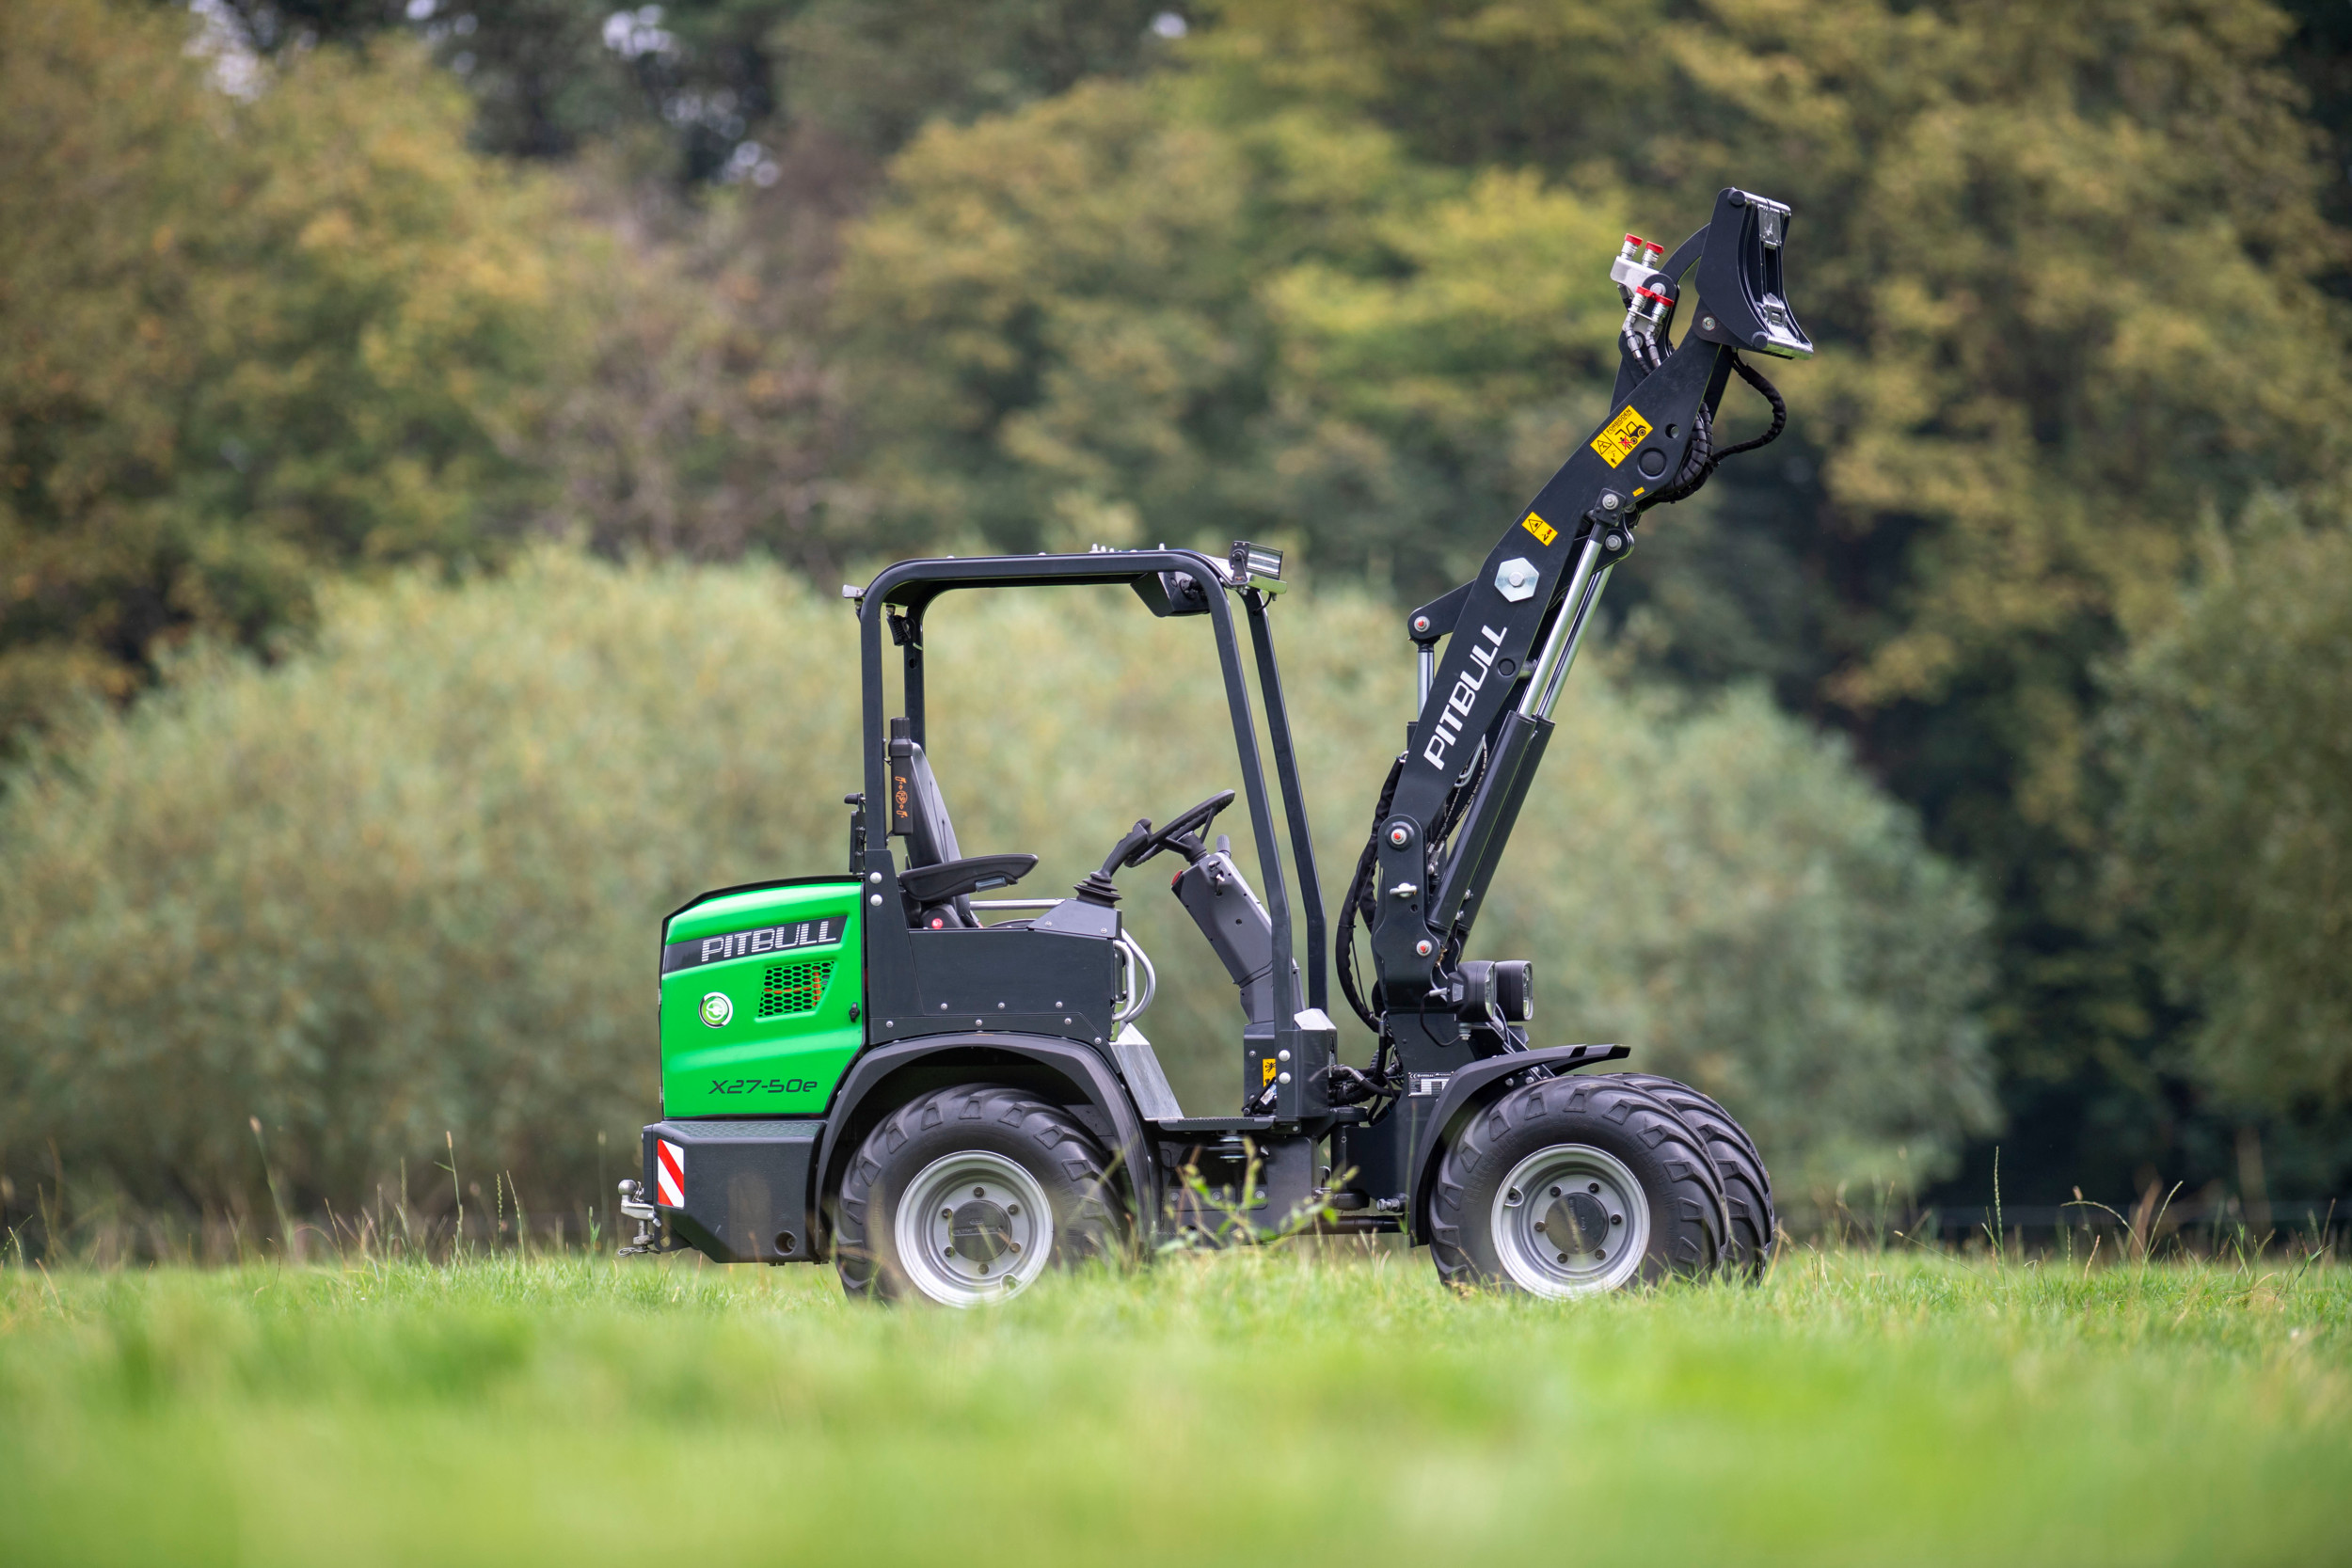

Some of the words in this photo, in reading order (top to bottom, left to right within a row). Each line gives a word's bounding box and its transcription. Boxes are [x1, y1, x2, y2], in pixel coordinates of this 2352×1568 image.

[1606, 408, 1632, 434] FORBIDDEN
[1423, 626, 1508, 770] PITBULL
[701, 920, 837, 962] PITBULL
[707, 1078, 818, 1095] X27-50e
